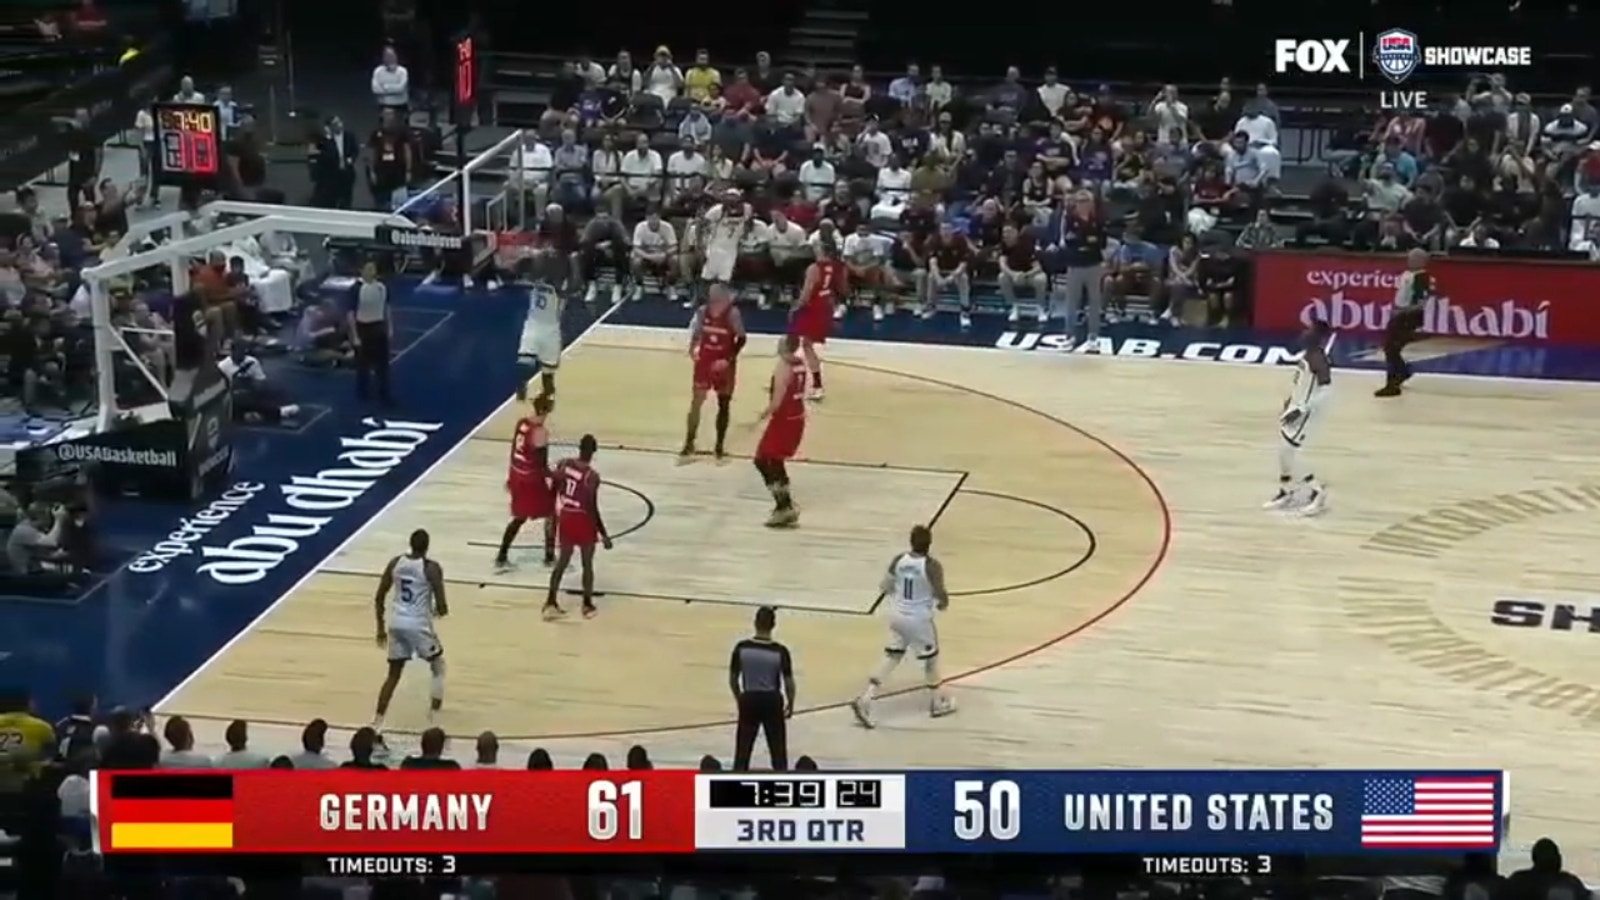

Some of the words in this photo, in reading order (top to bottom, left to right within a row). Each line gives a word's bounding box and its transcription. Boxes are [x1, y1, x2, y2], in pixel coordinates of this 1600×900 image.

[1300, 291, 1393, 331] abu
[994, 331, 1308, 366] USAB.COM
[58, 443, 178, 468] @USABasketball
[196, 512, 335, 585] abu
[401, 578, 413, 603] 5
[903, 577, 913, 601] 11
[1490, 599, 1600, 634] SH
